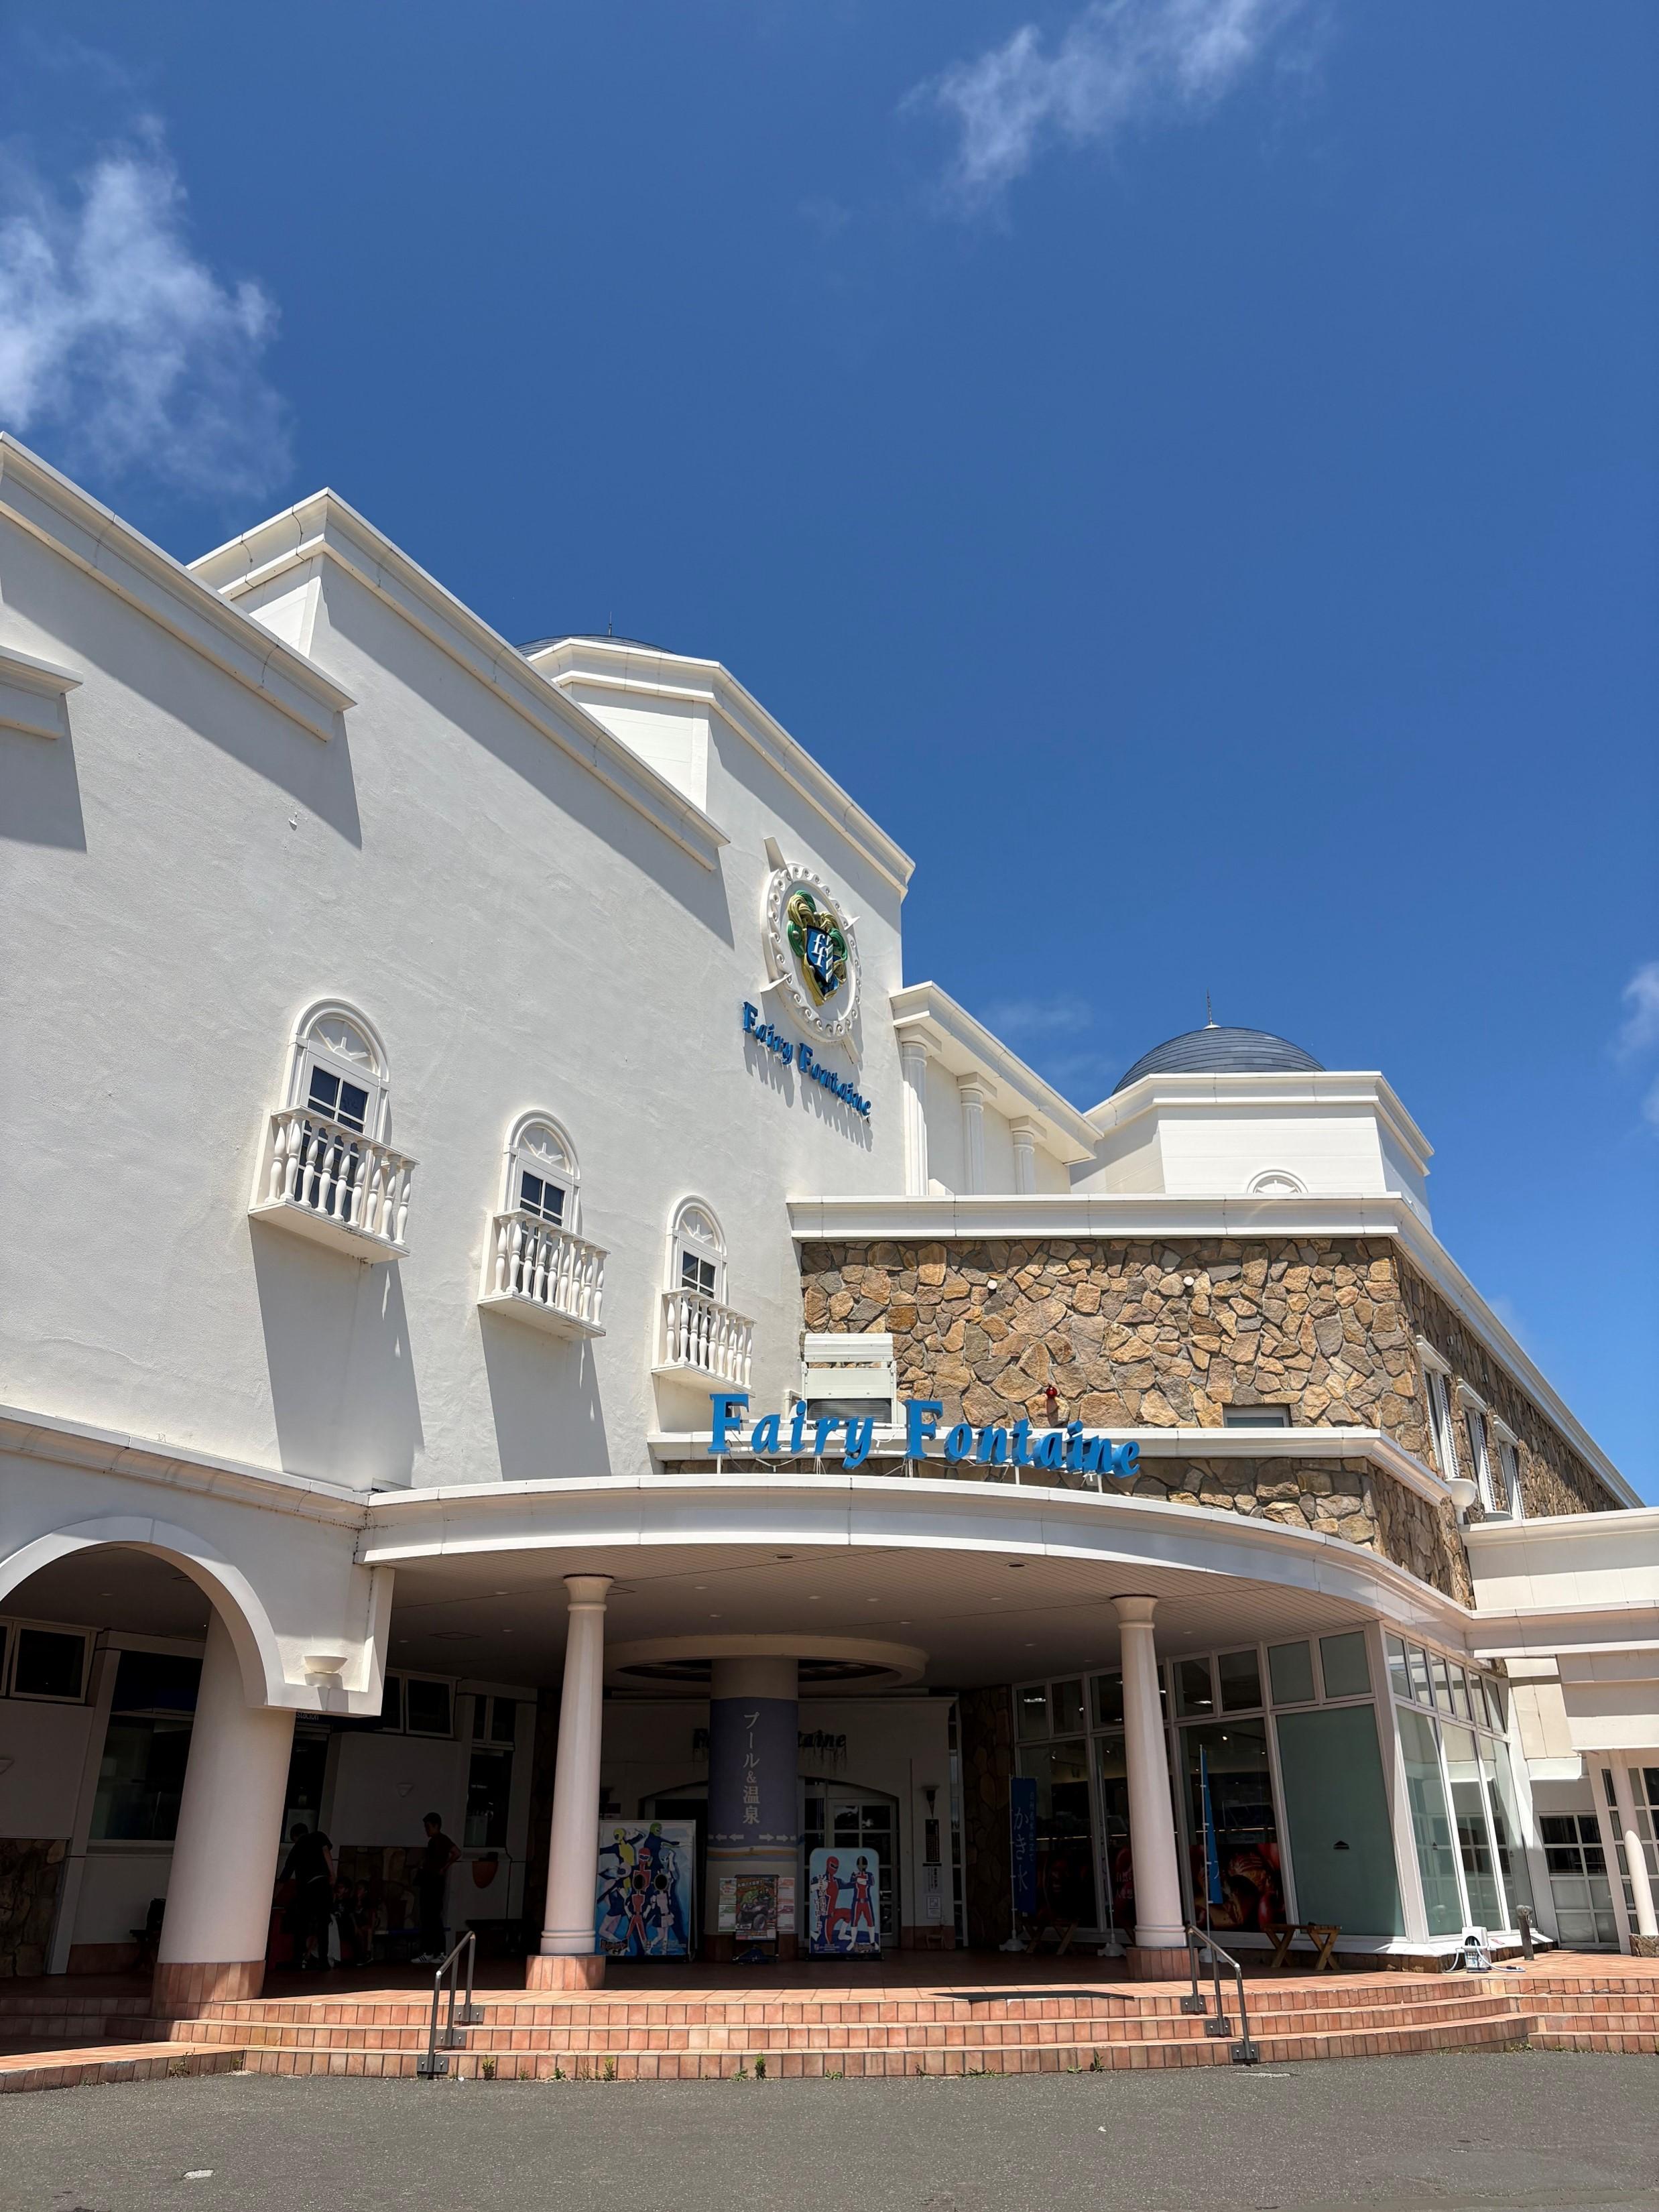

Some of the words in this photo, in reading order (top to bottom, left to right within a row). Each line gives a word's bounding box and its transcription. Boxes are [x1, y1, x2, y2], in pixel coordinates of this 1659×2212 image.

[743, 1001, 794, 1064] Fairy
[799, 1043, 871, 1116] Fontaine
[708, 1394, 874, 1469] Fairy
[905, 1400, 1140, 1477] Fontaine
[743, 1711, 761, 1825] プール&温泉
